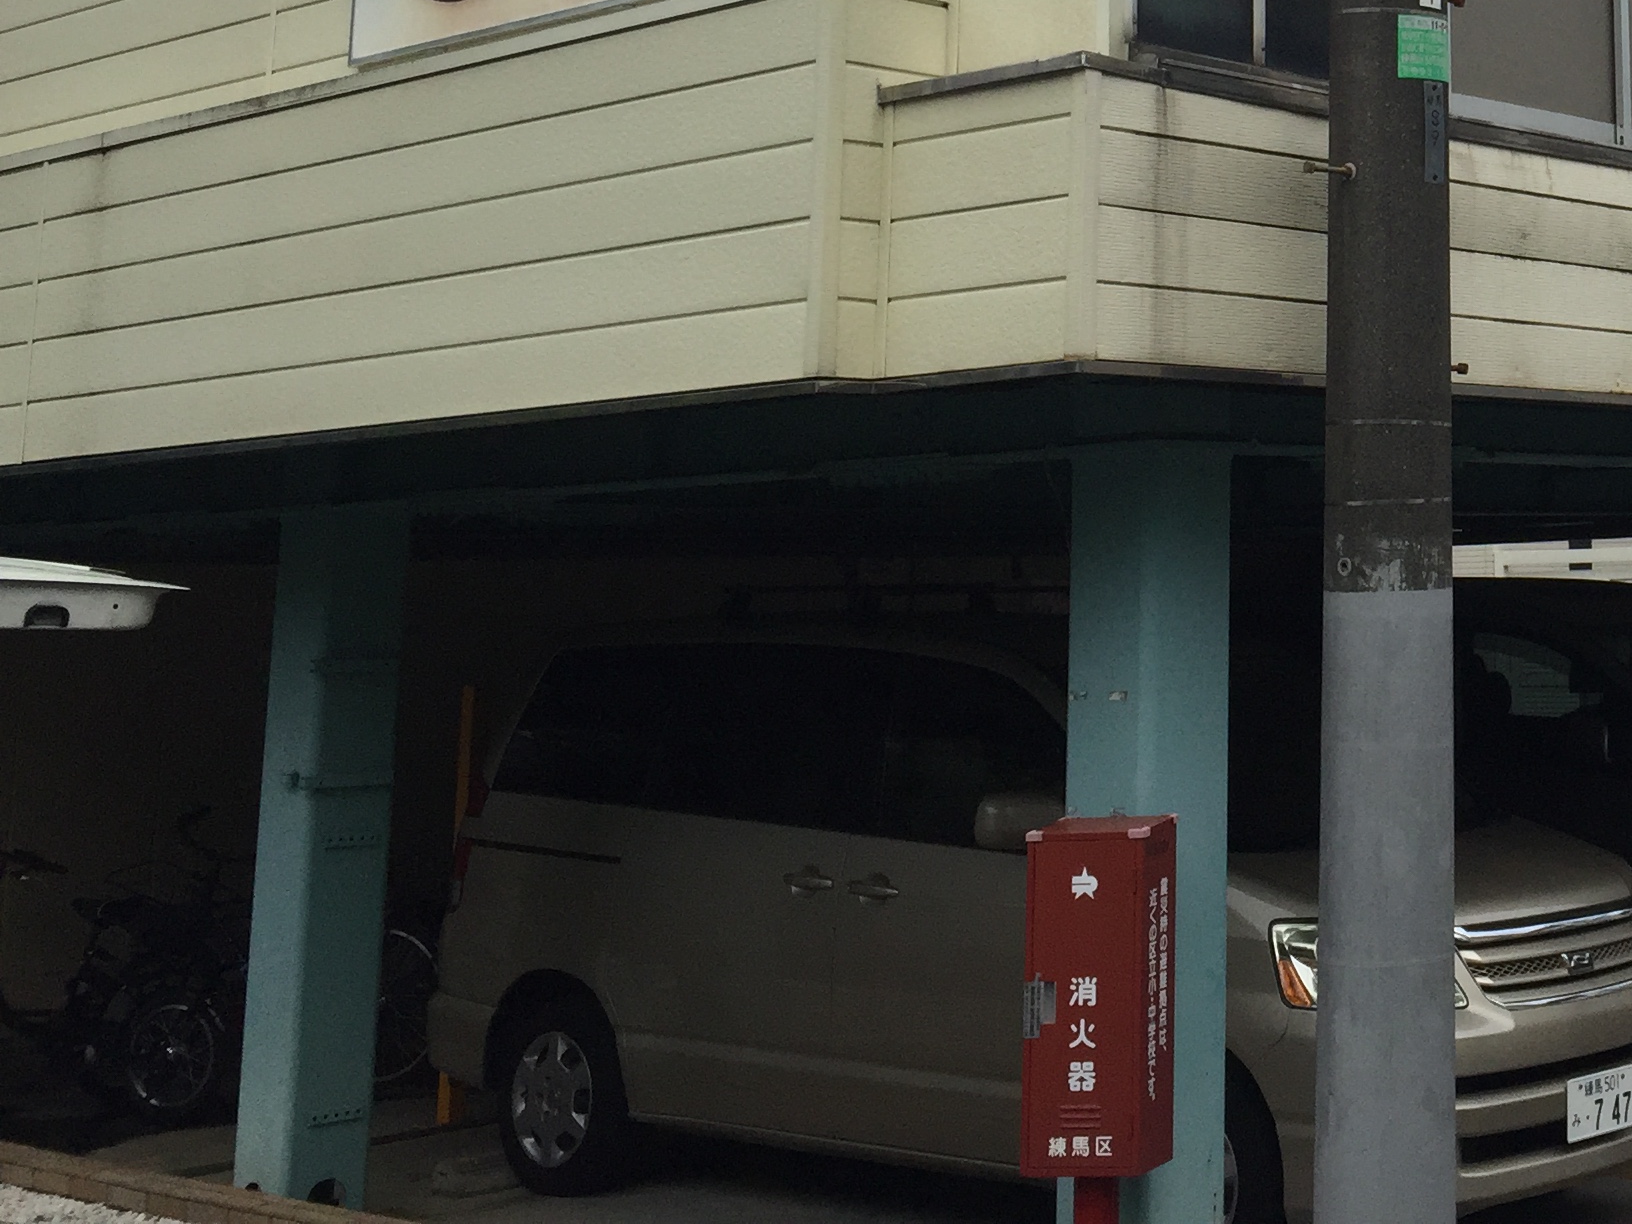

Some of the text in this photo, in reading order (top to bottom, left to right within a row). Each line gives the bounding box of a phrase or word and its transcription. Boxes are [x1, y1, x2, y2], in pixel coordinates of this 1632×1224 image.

[1068, 976, 1098, 1092] 消火器
[1047, 1135, 1113, 1158] 練馬区
